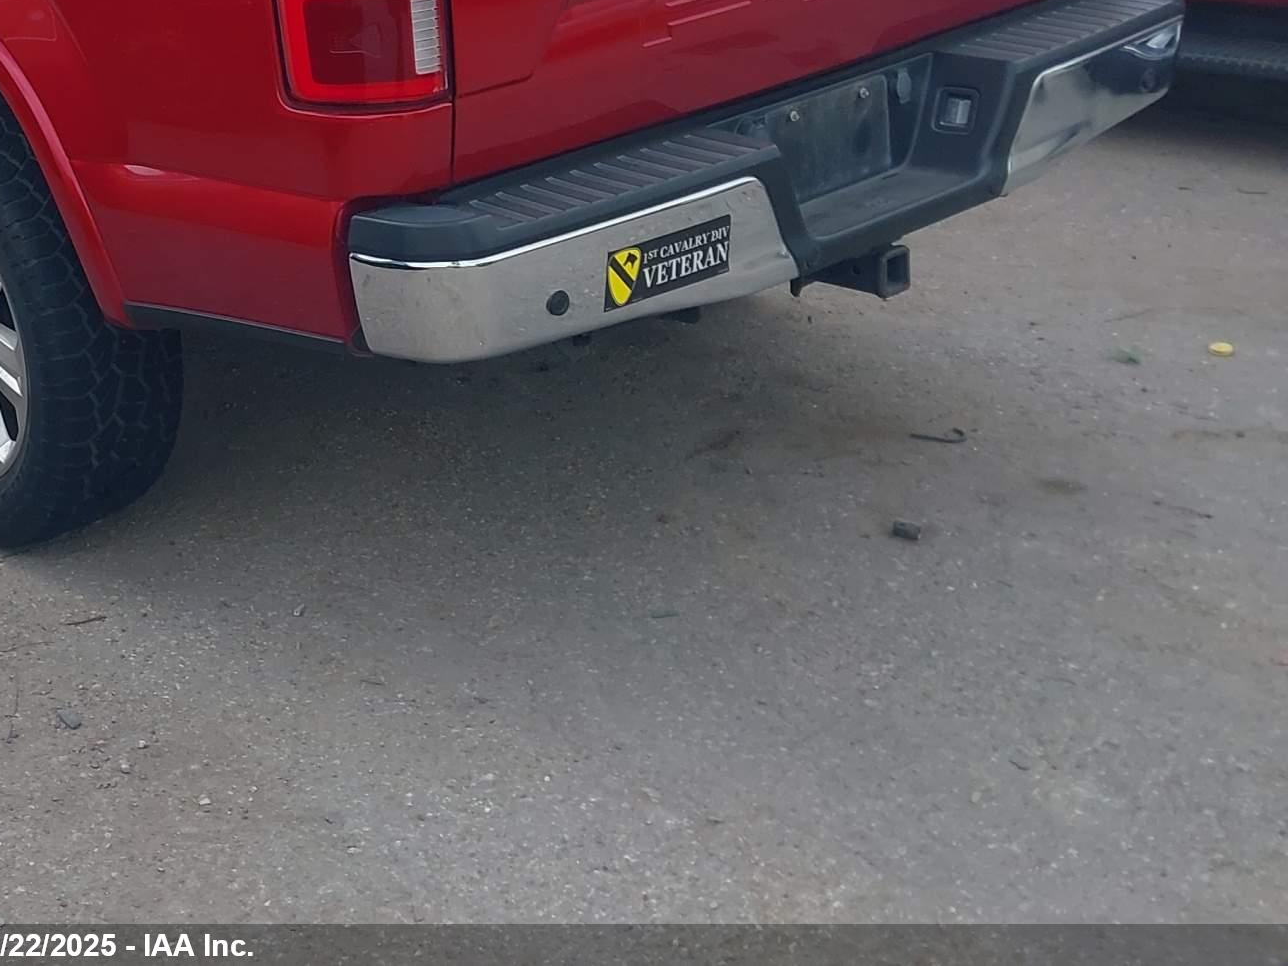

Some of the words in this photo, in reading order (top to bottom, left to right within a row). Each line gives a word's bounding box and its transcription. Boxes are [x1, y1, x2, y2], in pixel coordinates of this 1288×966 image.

[643, 249, 659, 265] 1ST
[660, 232, 710, 259] CAVALRY
[711, 225, 730, 242] DIV
[643, 240, 730, 288] VETERAN
